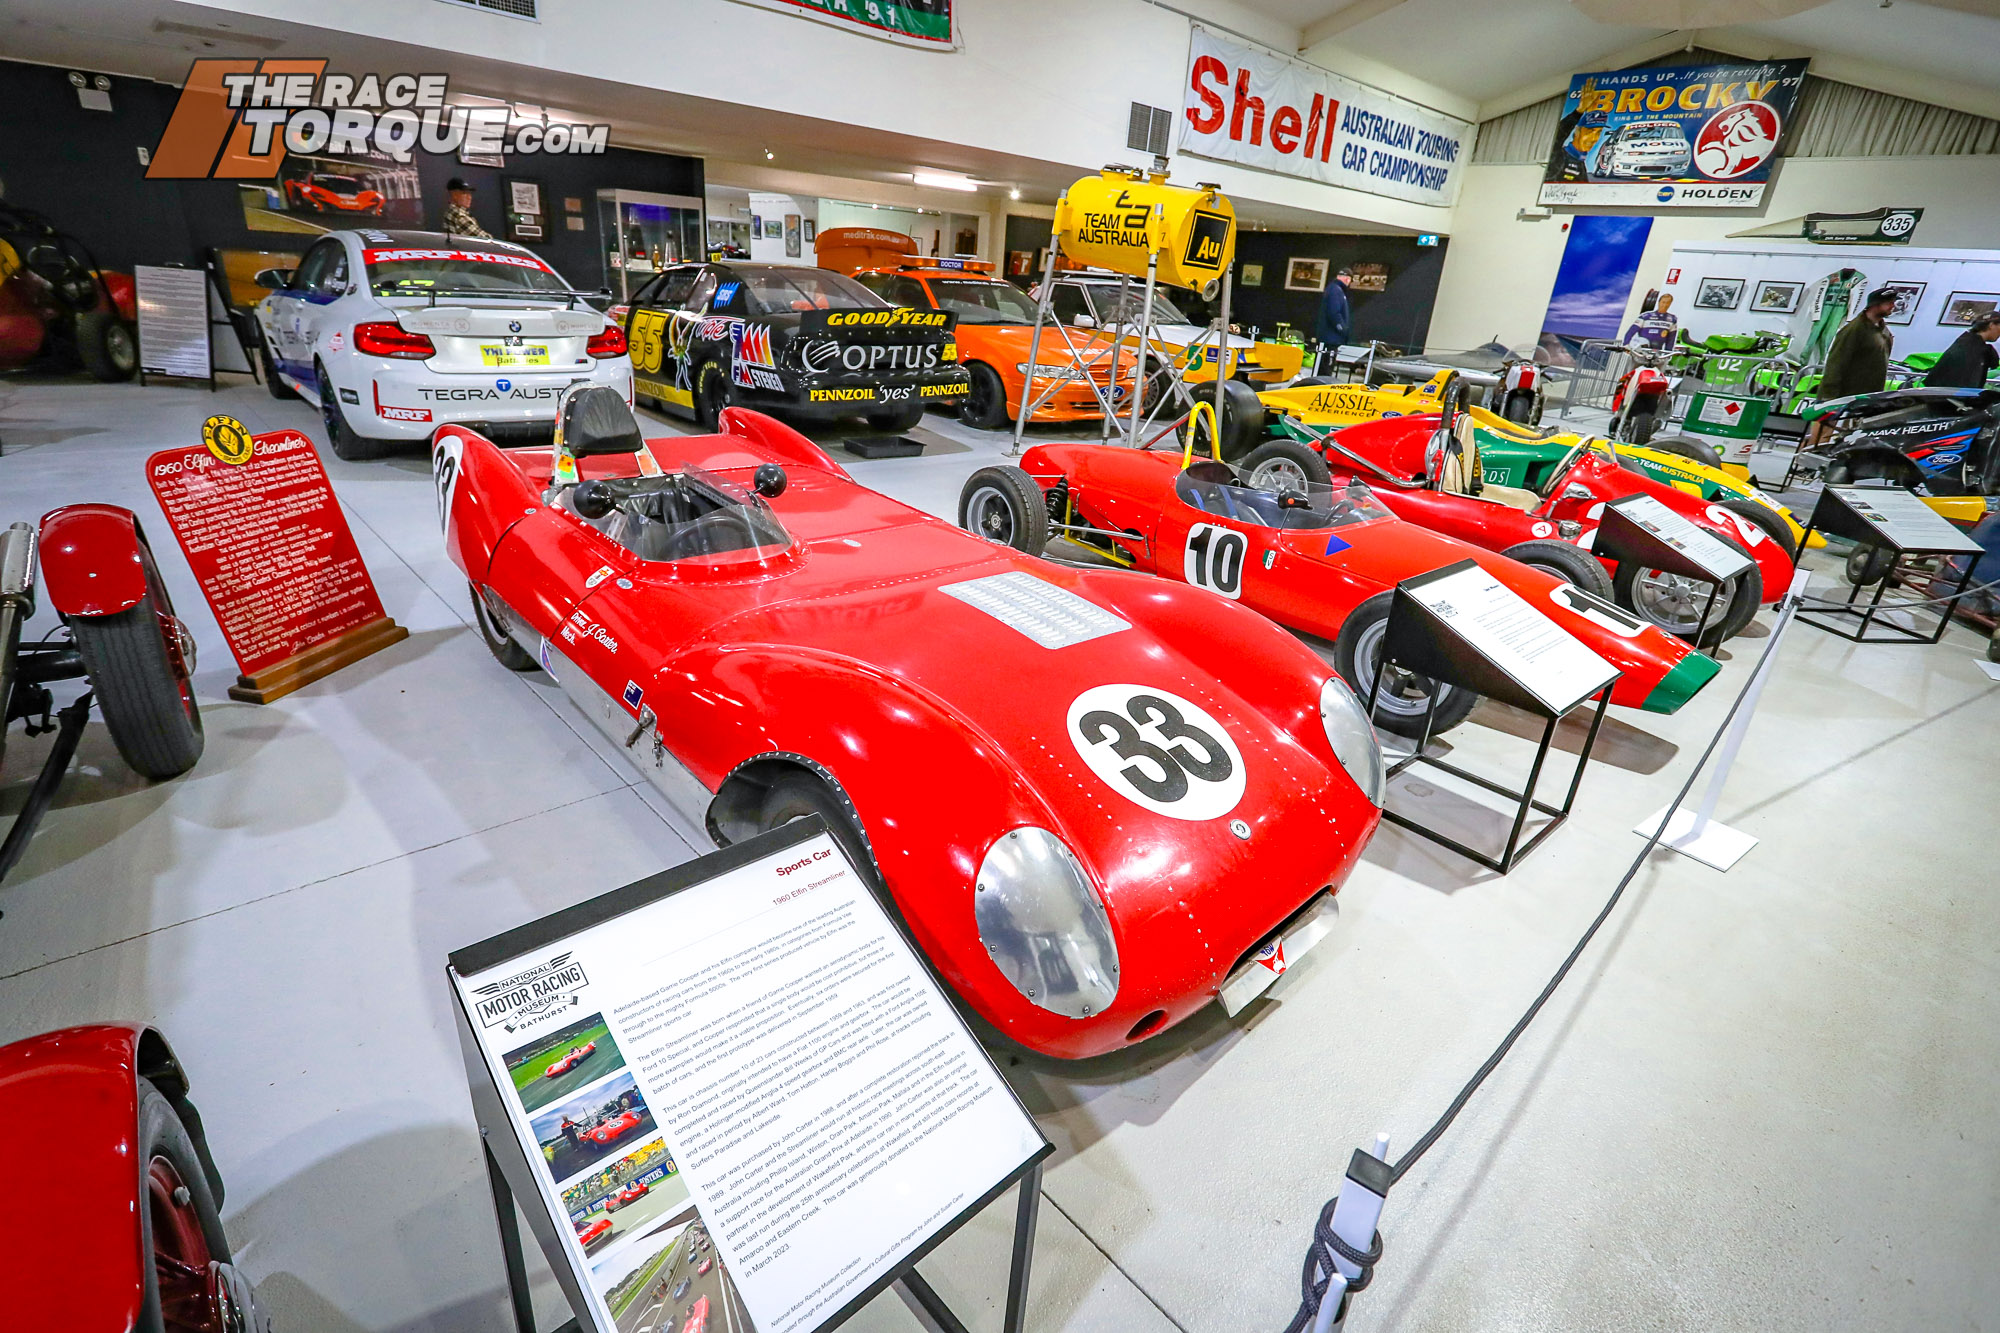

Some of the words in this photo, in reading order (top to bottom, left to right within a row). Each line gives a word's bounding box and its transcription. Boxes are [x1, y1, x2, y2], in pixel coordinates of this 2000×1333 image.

[1601, 74, 1648, 85] HANDS
[1730, 65, 1778, 78] retiring
[1593, 80, 1779, 113] BROCKY
[1782, 77, 1799, 87] 97
[1186, 55, 1340, 163] Shell
[1341, 105, 1415, 151] AUSTRALIAN
[1415, 130, 1460, 163] TOURING
[1631, 140, 1685, 149] Mobil
[1342, 142, 1366, 173] CAR
[1369, 150, 1448, 191] CHAMPIONSHIP
[1682, 189, 1753, 199] HOLDEN
[1084, 213, 1121, 229] TEAM
[1883, 214, 1910, 231] 335
[1078, 228, 1150, 248] AUSTRALIA
[1196, 235, 1221, 260] Au
[374, 250, 457, 260] MRF
[459, 251, 541, 269] TYRES
[941, 261, 962, 269] DOCTOR
[628, 309, 670, 373] 55
[842, 343, 938, 370] OPTUS
[750, 368, 785, 391] STEREO
[417, 389, 500, 401] TEGRA
[810, 389, 875, 401] PENNZOIL
[920, 383, 969, 397] PENNZOIL
[1310, 391, 1376, 411] AUSSIE
[383, 408, 430, 420] MRF
[1308, 407, 1373, 417] EXPERIENCE
[1868, 428, 1901, 437] NAVY
[1902, 421, 1949, 434] HEALTH
[154, 461, 183, 476] 1960
[184, 453, 216, 473] Elfin
[253, 436, 307, 456] Streamliner
[1932, 455, 1954, 464] Ford
[1706, 504, 1769, 549] 2
[1190, 526, 1243, 594] 10
[1079, 694, 1233, 803] 33
[776, 858, 812, 876] Sports
[813, 849, 831, 861] Car
[772, 893, 790, 906] 1960
[791, 887, 808, 899] Elfin
[808, 870, 845, 890] Streamliner
[501, 965, 550, 989] NATIONAL
[482, 987, 532, 1019] MOTOR
[531, 966, 580, 998] RACING
[518, 995, 559, 1016] MUSEUM
[520, 1005, 567, 1030] BATHURST
[661, 1103, 677, 1113] This
[677, 1097, 687, 1106] car
[694, 1081, 718, 1096] chassis
[718, 1068, 740, 1083] number
[755, 1055, 764, 1063] 23
[763, 1049, 776, 1058] cars
[776, 1031, 807, 1051] constructed
[806, 1020, 829, 1035] between
[829, 1012, 842, 1022] 1959
[842, 1006, 852, 1015] and
[866, 993, 876, 1002] and
[895, 974, 910, 986] owned
[690, 1153, 714, 1170] Surfers
[713, 1137, 741, 1156] Paradise
[742, 1128, 754, 1139] and
[738, 1244, 764, 1265] Amaroo
[764, 1234, 777, 1247] and
[776, 1218, 801, 1238] Eastern
[822, 1194, 836, 1205] This
[836, 1187, 846, 1196] car
[845, 1179, 858, 1189] was
[858, 1159, 887, 1183] generously
[887, 1143, 909, 1161] donated
[913, 1134, 923, 1142] the
[922, 1119, 943, 1136] National
[942, 1110, 957, 1122] Motor
[956, 1099, 974, 1112] Racing
[972, 1085, 993, 1101] Museum
[743, 1270, 752, 1278] in
[751, 1255, 773, 1272] March
[770, 1309, 790, 1328] National
[790, 1299, 804, 1312] Motor
[804, 1287, 821, 1302] Racing
[820, 1272, 840, 1289] Museum
[839, 1256, 861, 1275] Collection
